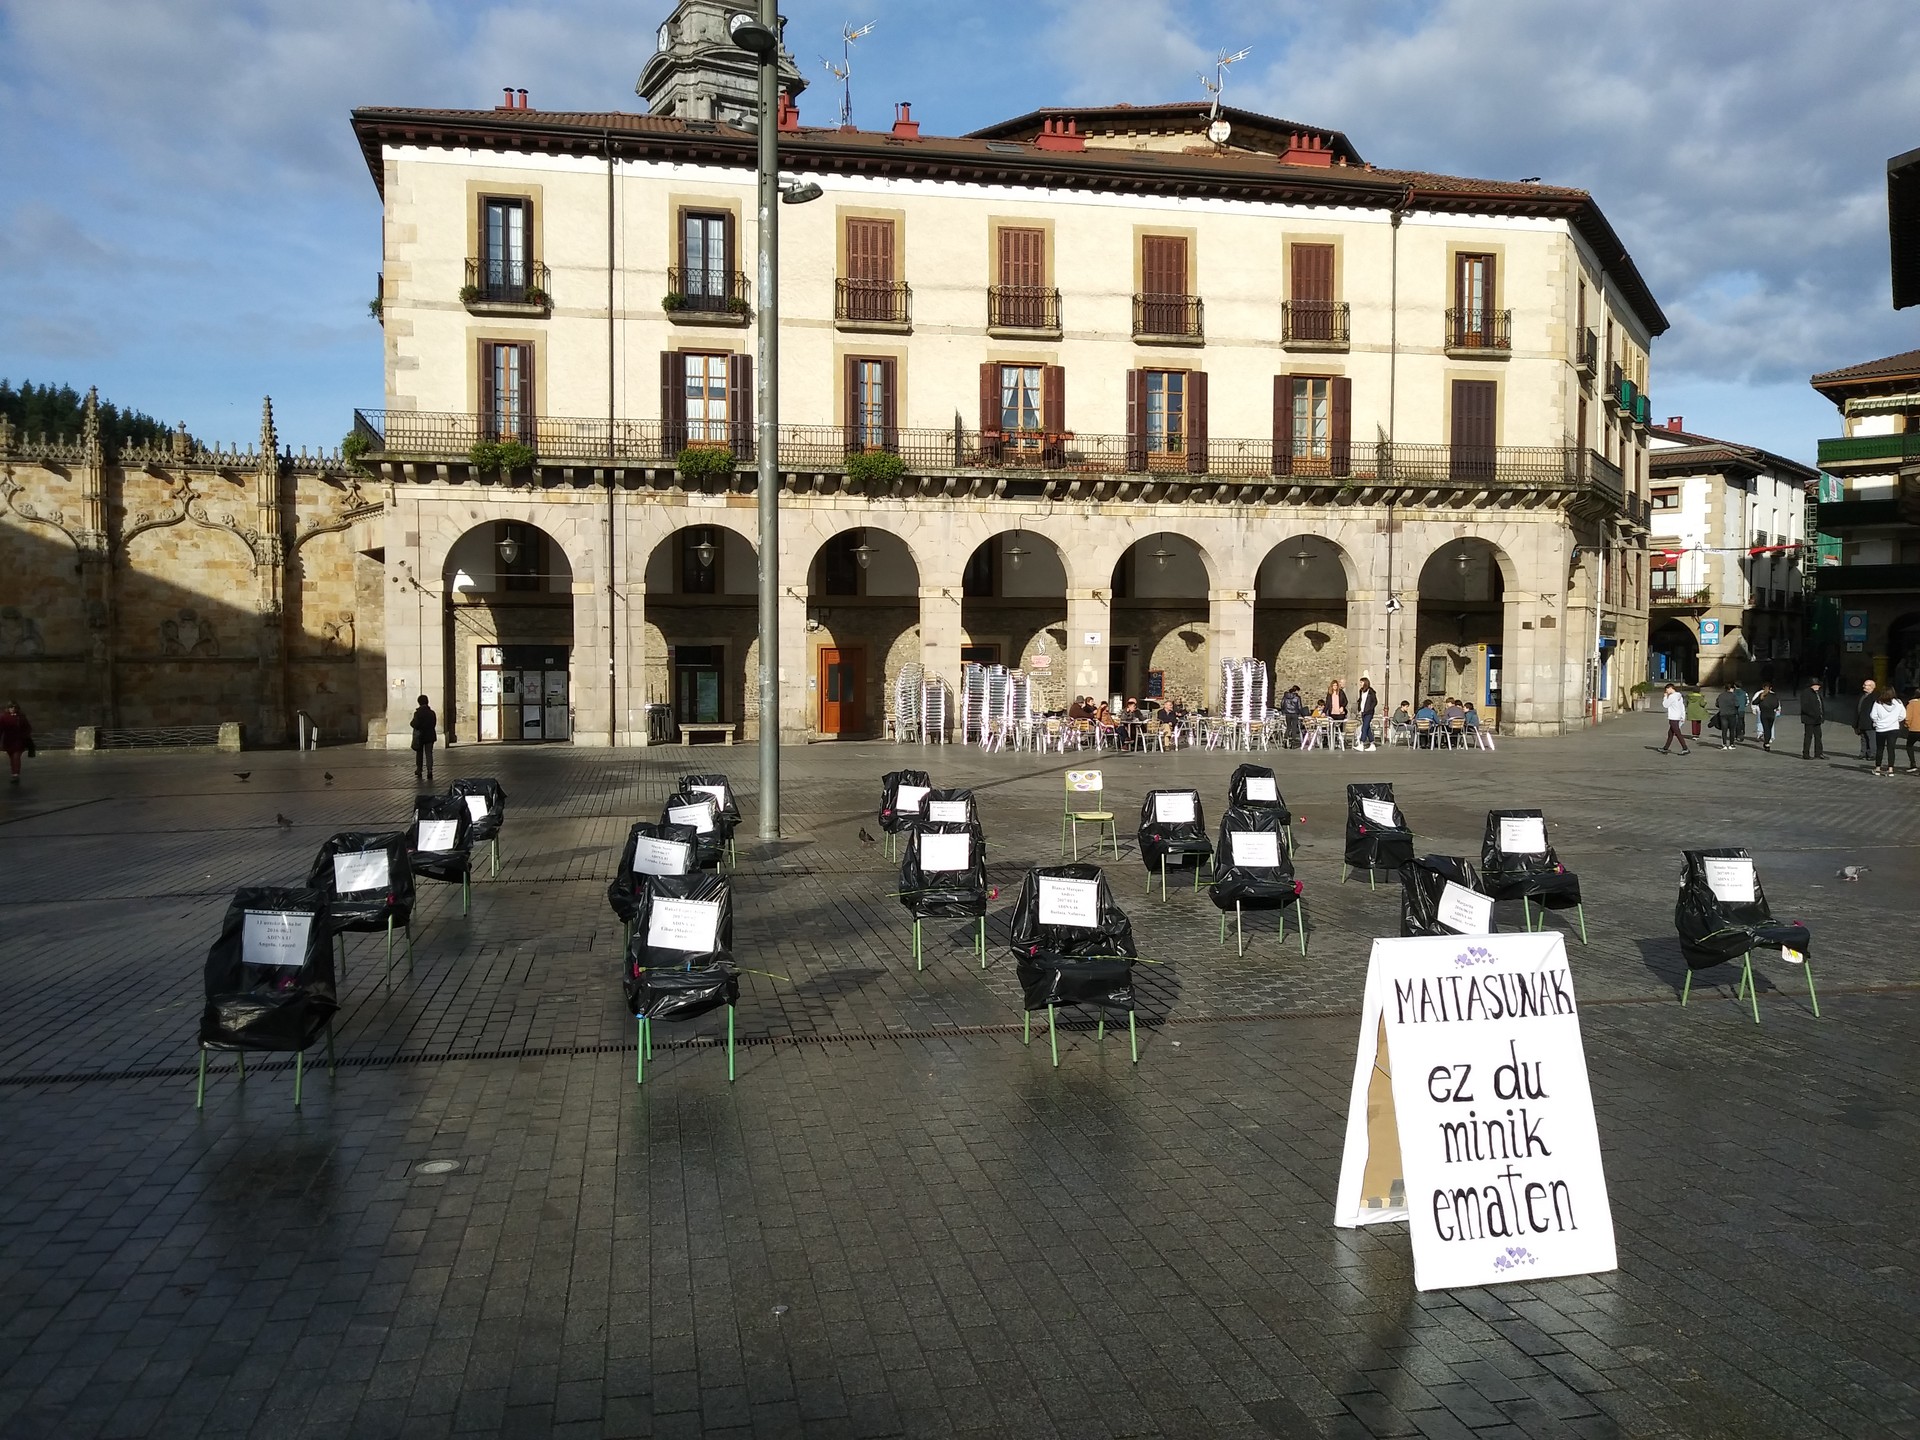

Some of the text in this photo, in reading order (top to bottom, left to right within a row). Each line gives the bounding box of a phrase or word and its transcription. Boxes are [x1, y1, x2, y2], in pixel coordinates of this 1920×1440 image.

[1394, 969, 1575, 1024] MAITASUNAK
[1428, 1039, 1550, 1103] ez du
[1439, 1108, 1552, 1163] minik
[1433, 1164, 1578, 1242] ematen
